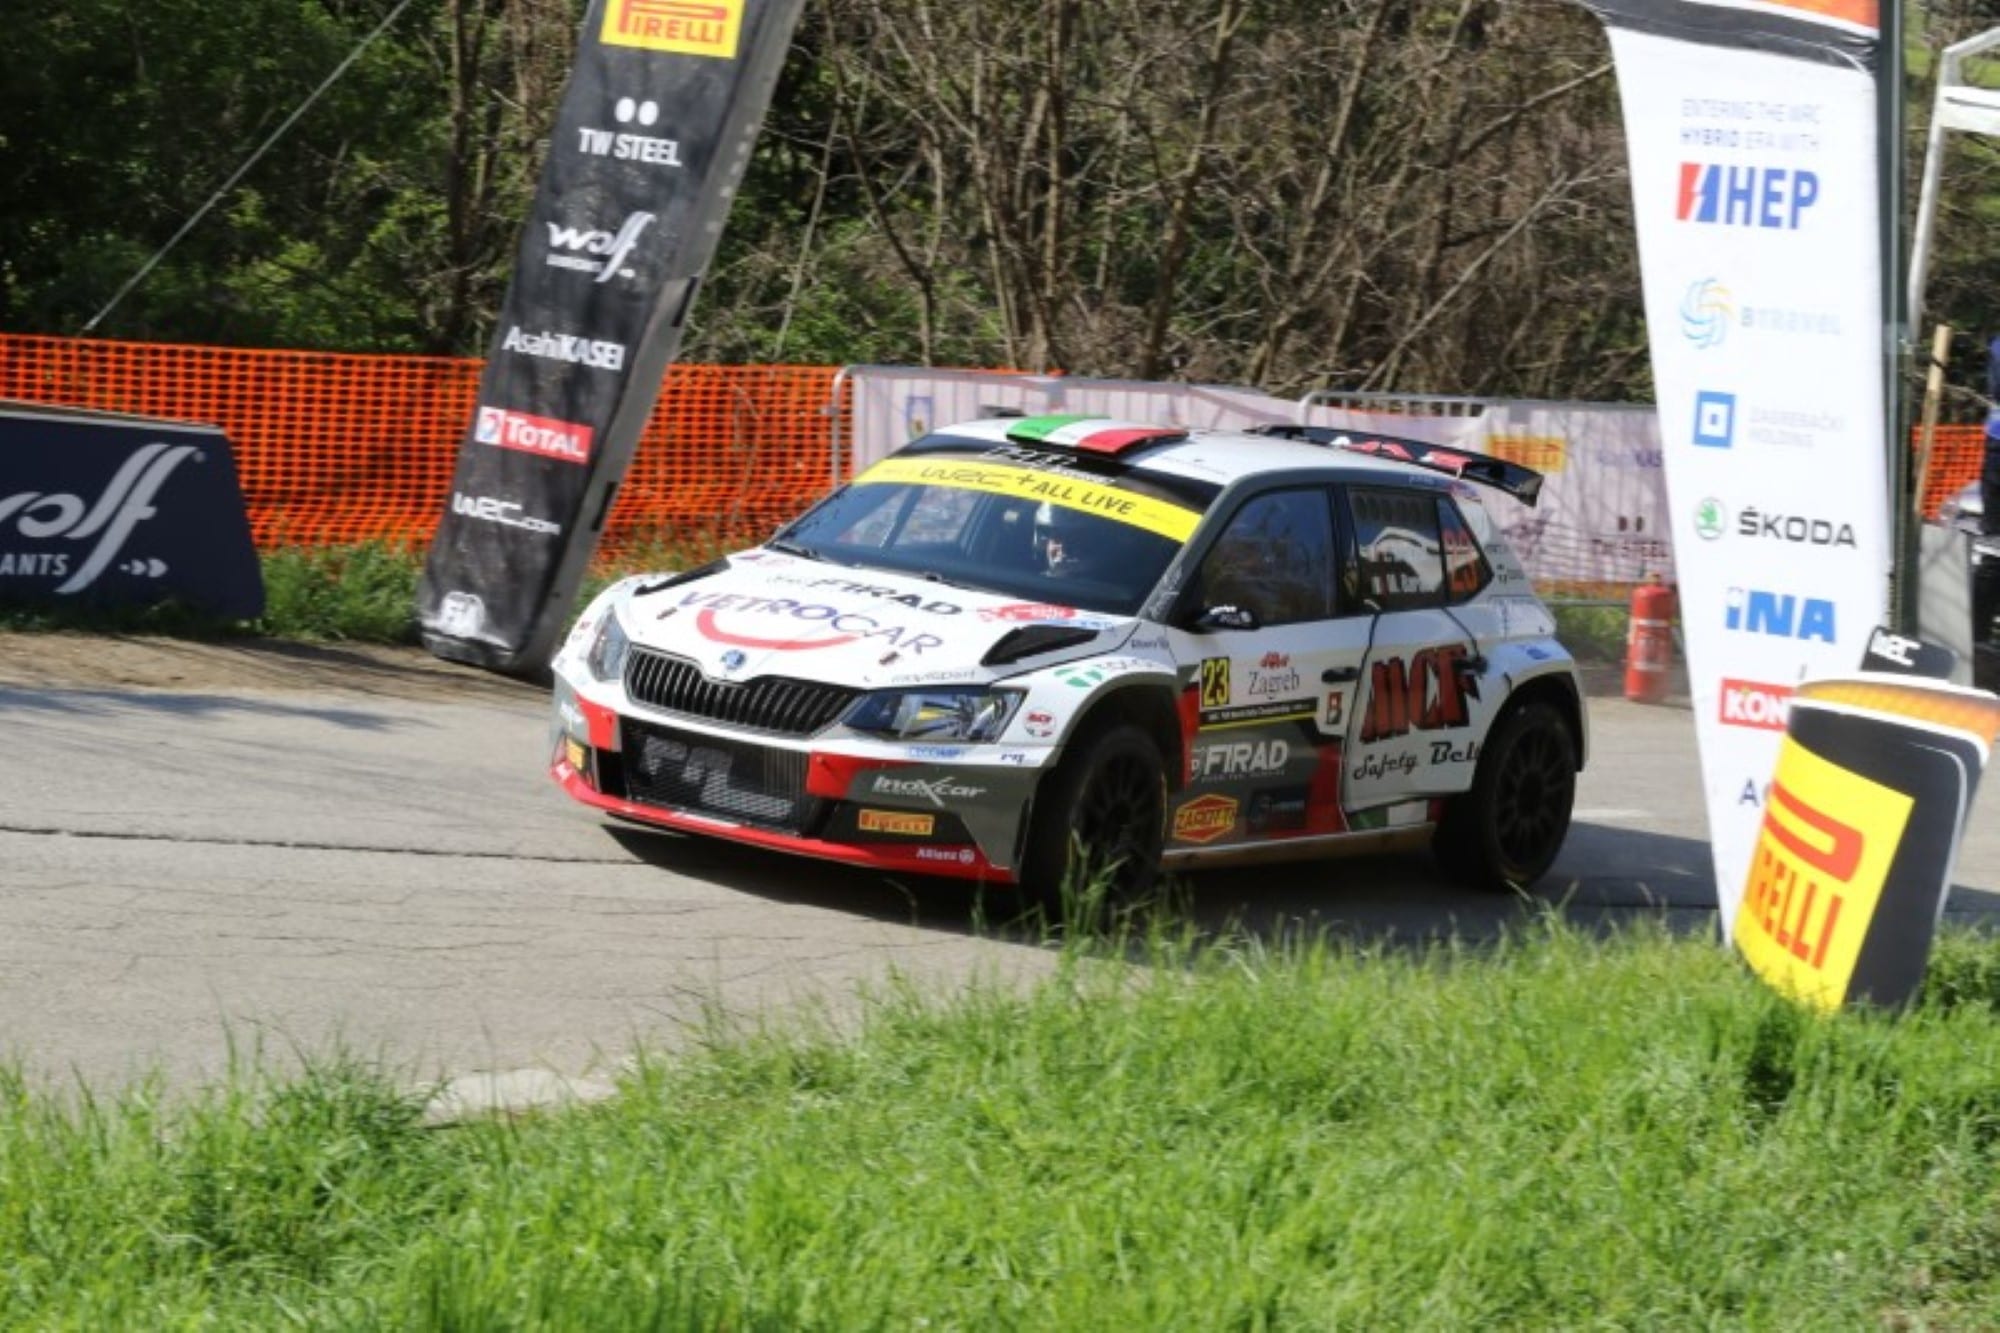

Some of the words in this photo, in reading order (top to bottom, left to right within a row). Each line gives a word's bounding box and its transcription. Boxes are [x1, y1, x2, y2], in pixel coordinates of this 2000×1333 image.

[617, 0, 729, 45] PIRELLI
[578, 127, 613, 155] TW
[613, 135, 682, 167] STEEL
[1724, 166, 1821, 230] HEP
[1032, 480, 1073, 502] ALL
[1081, 488, 1138, 516] LIVE
[1738, 505, 1858, 549] ŠKODA
[1202, 658, 1229, 707] 23
[1203, 739, 1289, 776] FIRAD
[1353, 750, 1419, 781] Safety
[916, 848, 959, 861] Allianz
